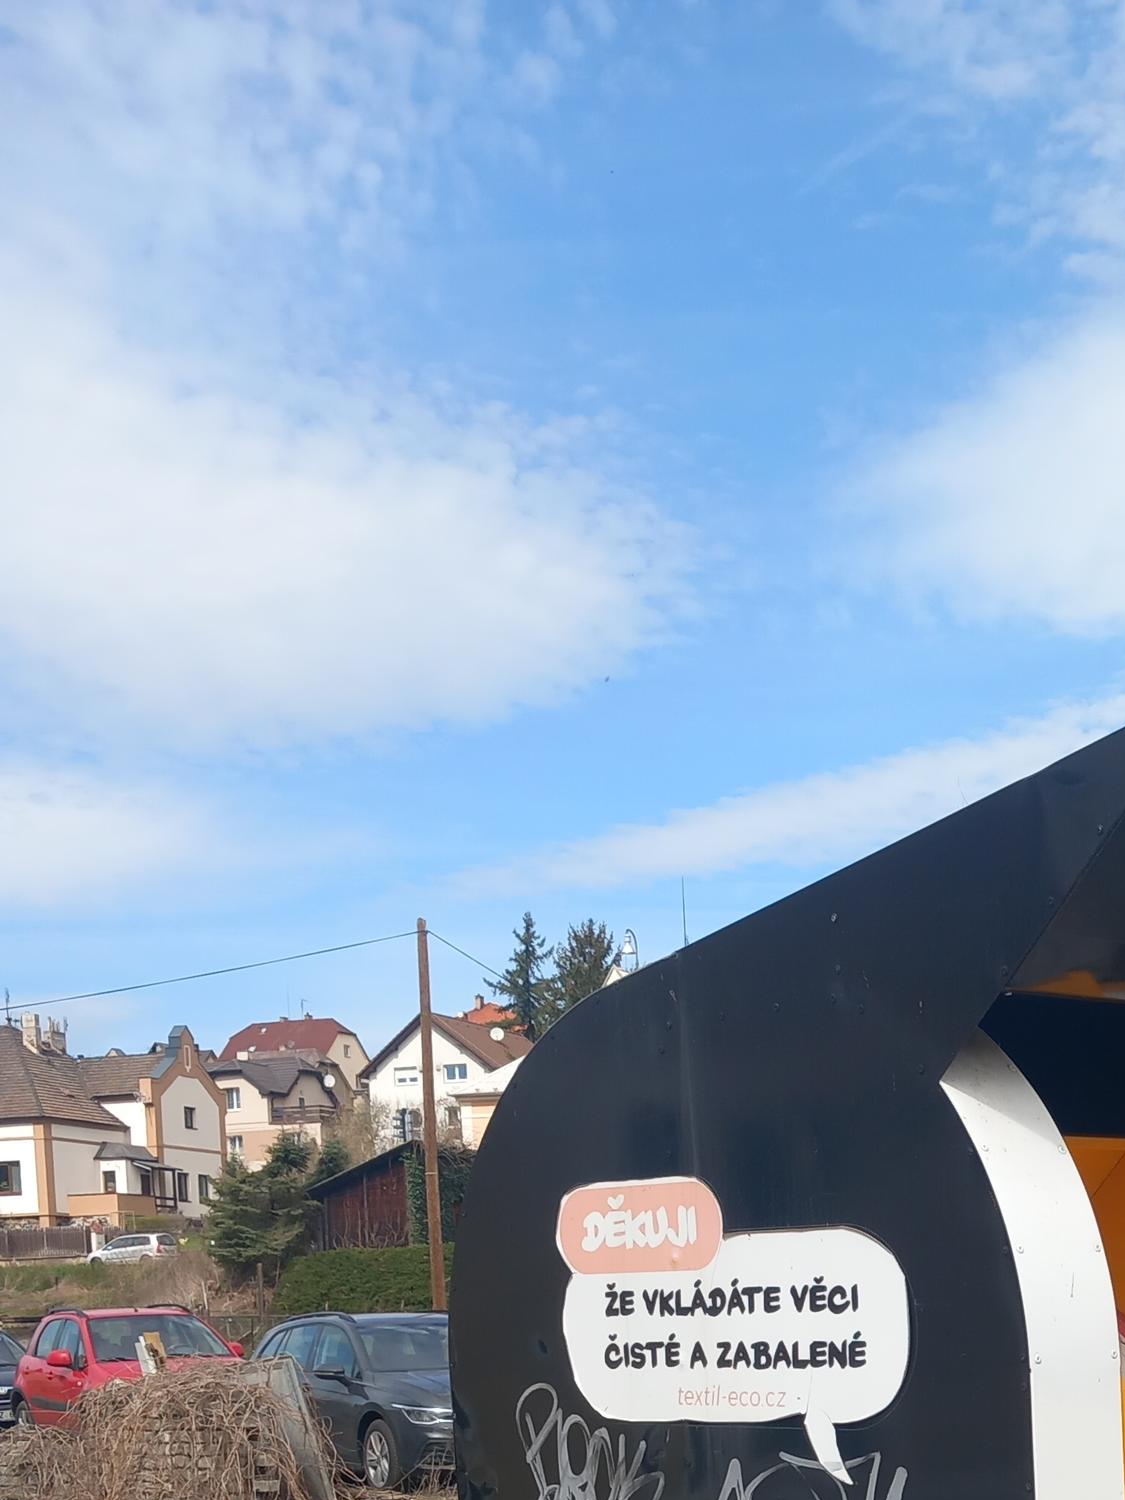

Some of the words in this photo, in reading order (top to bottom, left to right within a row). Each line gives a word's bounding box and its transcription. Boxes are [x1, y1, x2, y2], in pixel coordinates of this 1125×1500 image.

[581, 1194, 697, 1252] DĚKUJI
[604, 1282, 635, 1317] ŽE
[642, 1278, 781, 1318] VKLÁDÁTE
[790, 1275, 859, 1314] VĚCI
[604, 1333, 681, 1369] ČISTÉ
[689, 1340, 709, 1369] A
[716, 1331, 867, 1370] ZABALENÉ
[677, 1384, 787, 1408] textil-eco.cz
